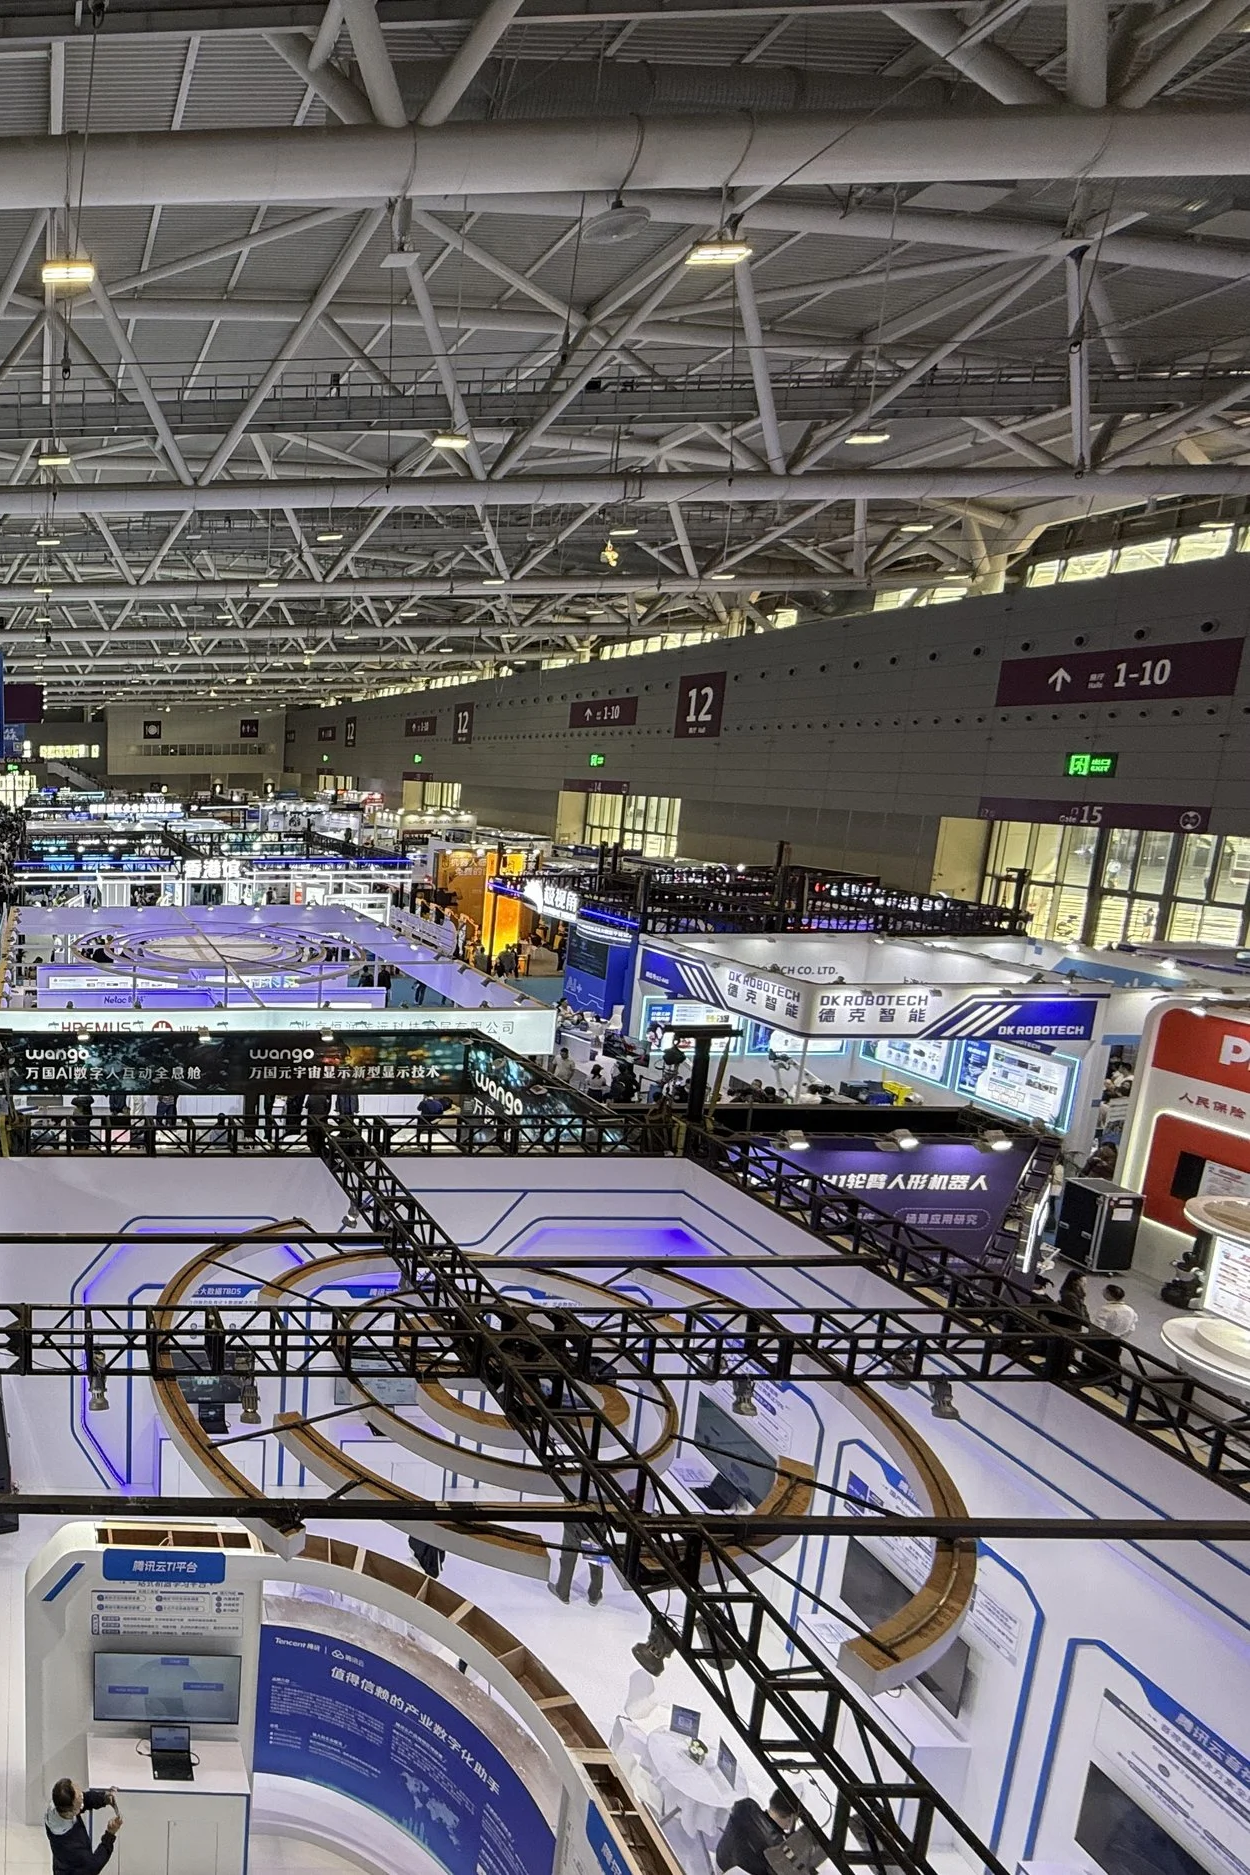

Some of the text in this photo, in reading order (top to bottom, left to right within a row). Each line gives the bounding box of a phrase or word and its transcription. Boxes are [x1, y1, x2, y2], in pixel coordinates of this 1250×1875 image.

[1114, 659, 1171, 688] 1-10
[686, 686, 713, 722] 12
[603, 705, 620, 720] 1-10
[457, 711, 469, 734] 12
[347, 723, 354, 740] 12
[1059, 814, 1077, 824] Gate
[1080, 806, 1103, 824] 15
[184, 859, 241, 879] 香港馆
[797, 966, 839, 975] CO. LTD.
[729, 971, 800, 1003] DK ROBOTECH
[104, 995, 127, 1004] Netac
[727, 984, 799, 1019] 德克智能
[820, 995, 929, 1006] DK ROBOTECH
[818, 1008, 927, 1023] 德克智能
[998, 1026, 1085, 1035] DK ROBOTECH
[25, 1048, 90, 1064] wango
[250, 1048, 314, 1063] wango
[1218, 1034, 1250, 1073] P
[25, 1066, 201, 1081] 万国AI数字人互动全息舱
[249, 1065, 440, 1080] 万国元宇宙显示新型显示技术
[475, 1070, 523, 1115] wango
[1178, 1092, 1246, 1120] 人民保险
[905, 1213, 978, 1225] 场景应用研究
[132, 1560, 198, 1573] 腾讯云TI平台
[275, 1637, 306, 1648] Tencent
[330, 1666, 500, 1796] 值得信赖的产业数字化助手
